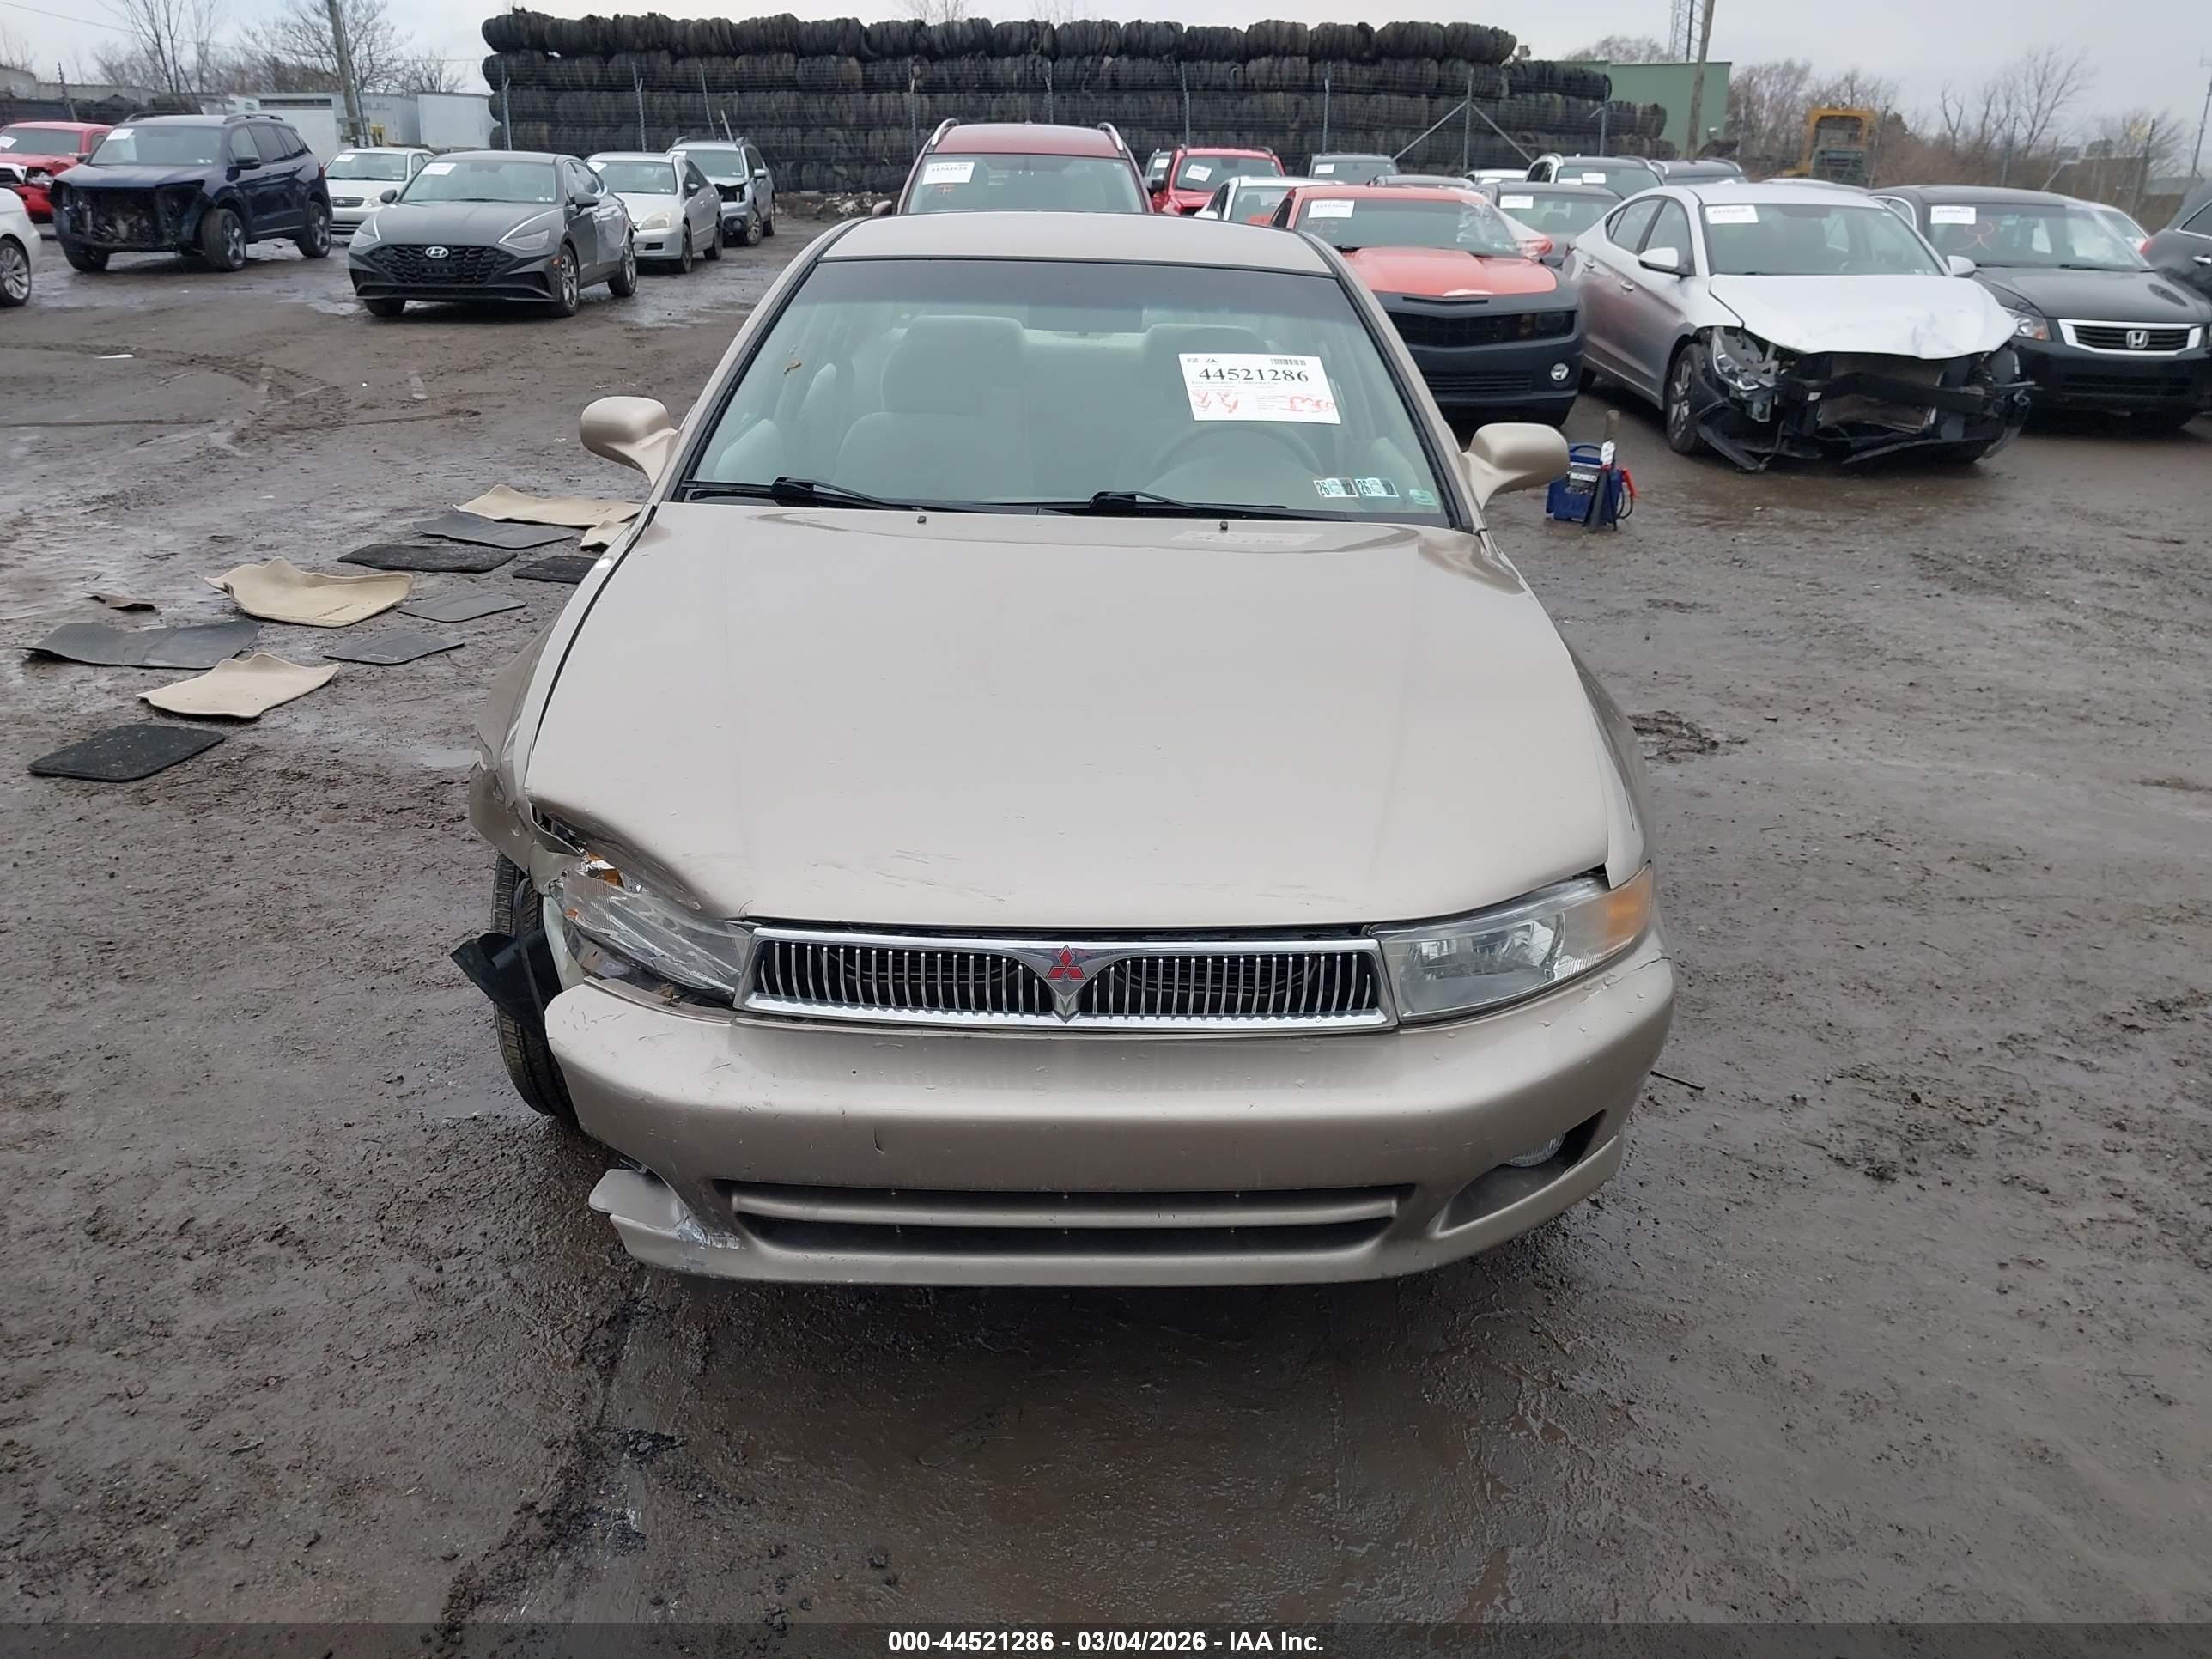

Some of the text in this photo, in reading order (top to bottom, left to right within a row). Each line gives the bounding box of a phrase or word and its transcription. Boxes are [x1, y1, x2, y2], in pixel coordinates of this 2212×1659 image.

[1199, 368, 1310, 383] 44521286
[1316, 481, 1330, 495] 26
[1357, 480, 1372, 495] 26
